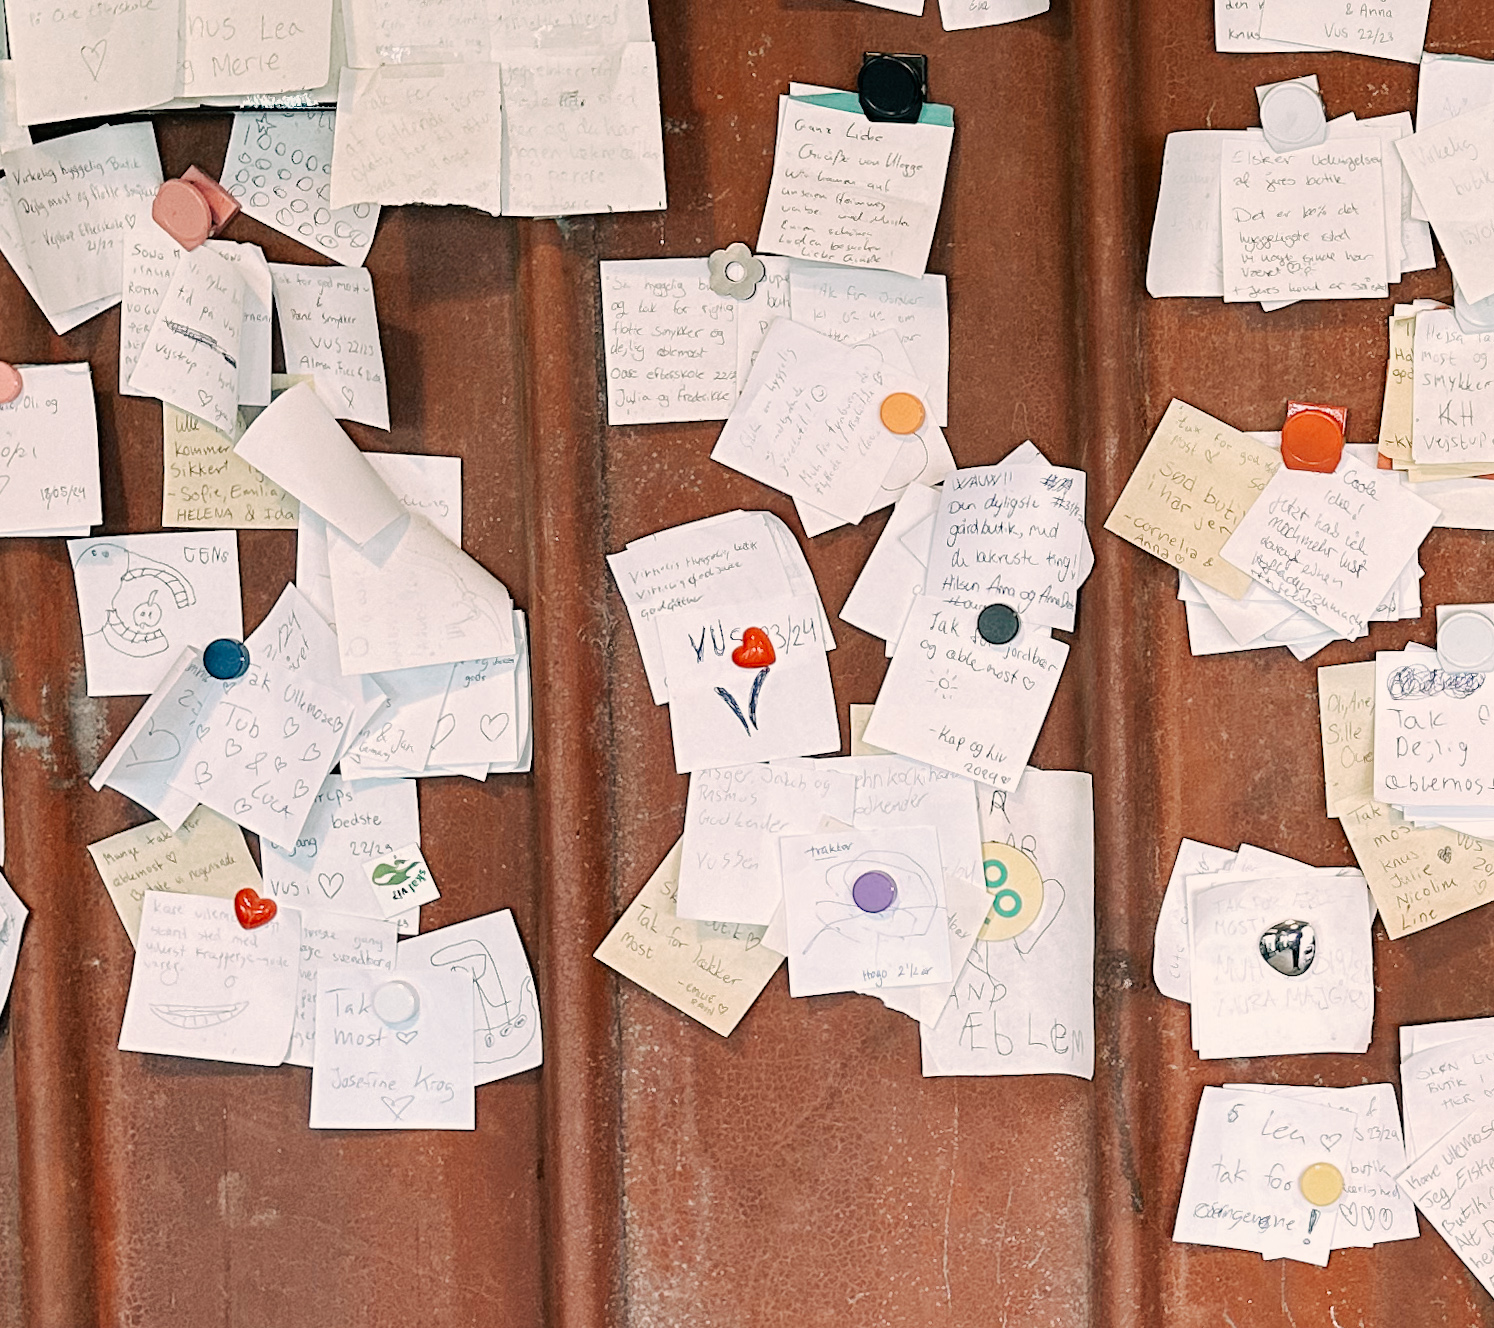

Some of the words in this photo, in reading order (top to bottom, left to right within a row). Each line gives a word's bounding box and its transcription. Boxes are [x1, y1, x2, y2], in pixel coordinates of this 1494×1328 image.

[1360, 4, 1393, 18] Anna
[177, 508, 233, 521] HELENA
[264, 507, 295, 520] Ida
[1386, 708, 1447, 729] Tak
[636, 904, 659, 935] Tak
[325, 987, 372, 1017] Tak
